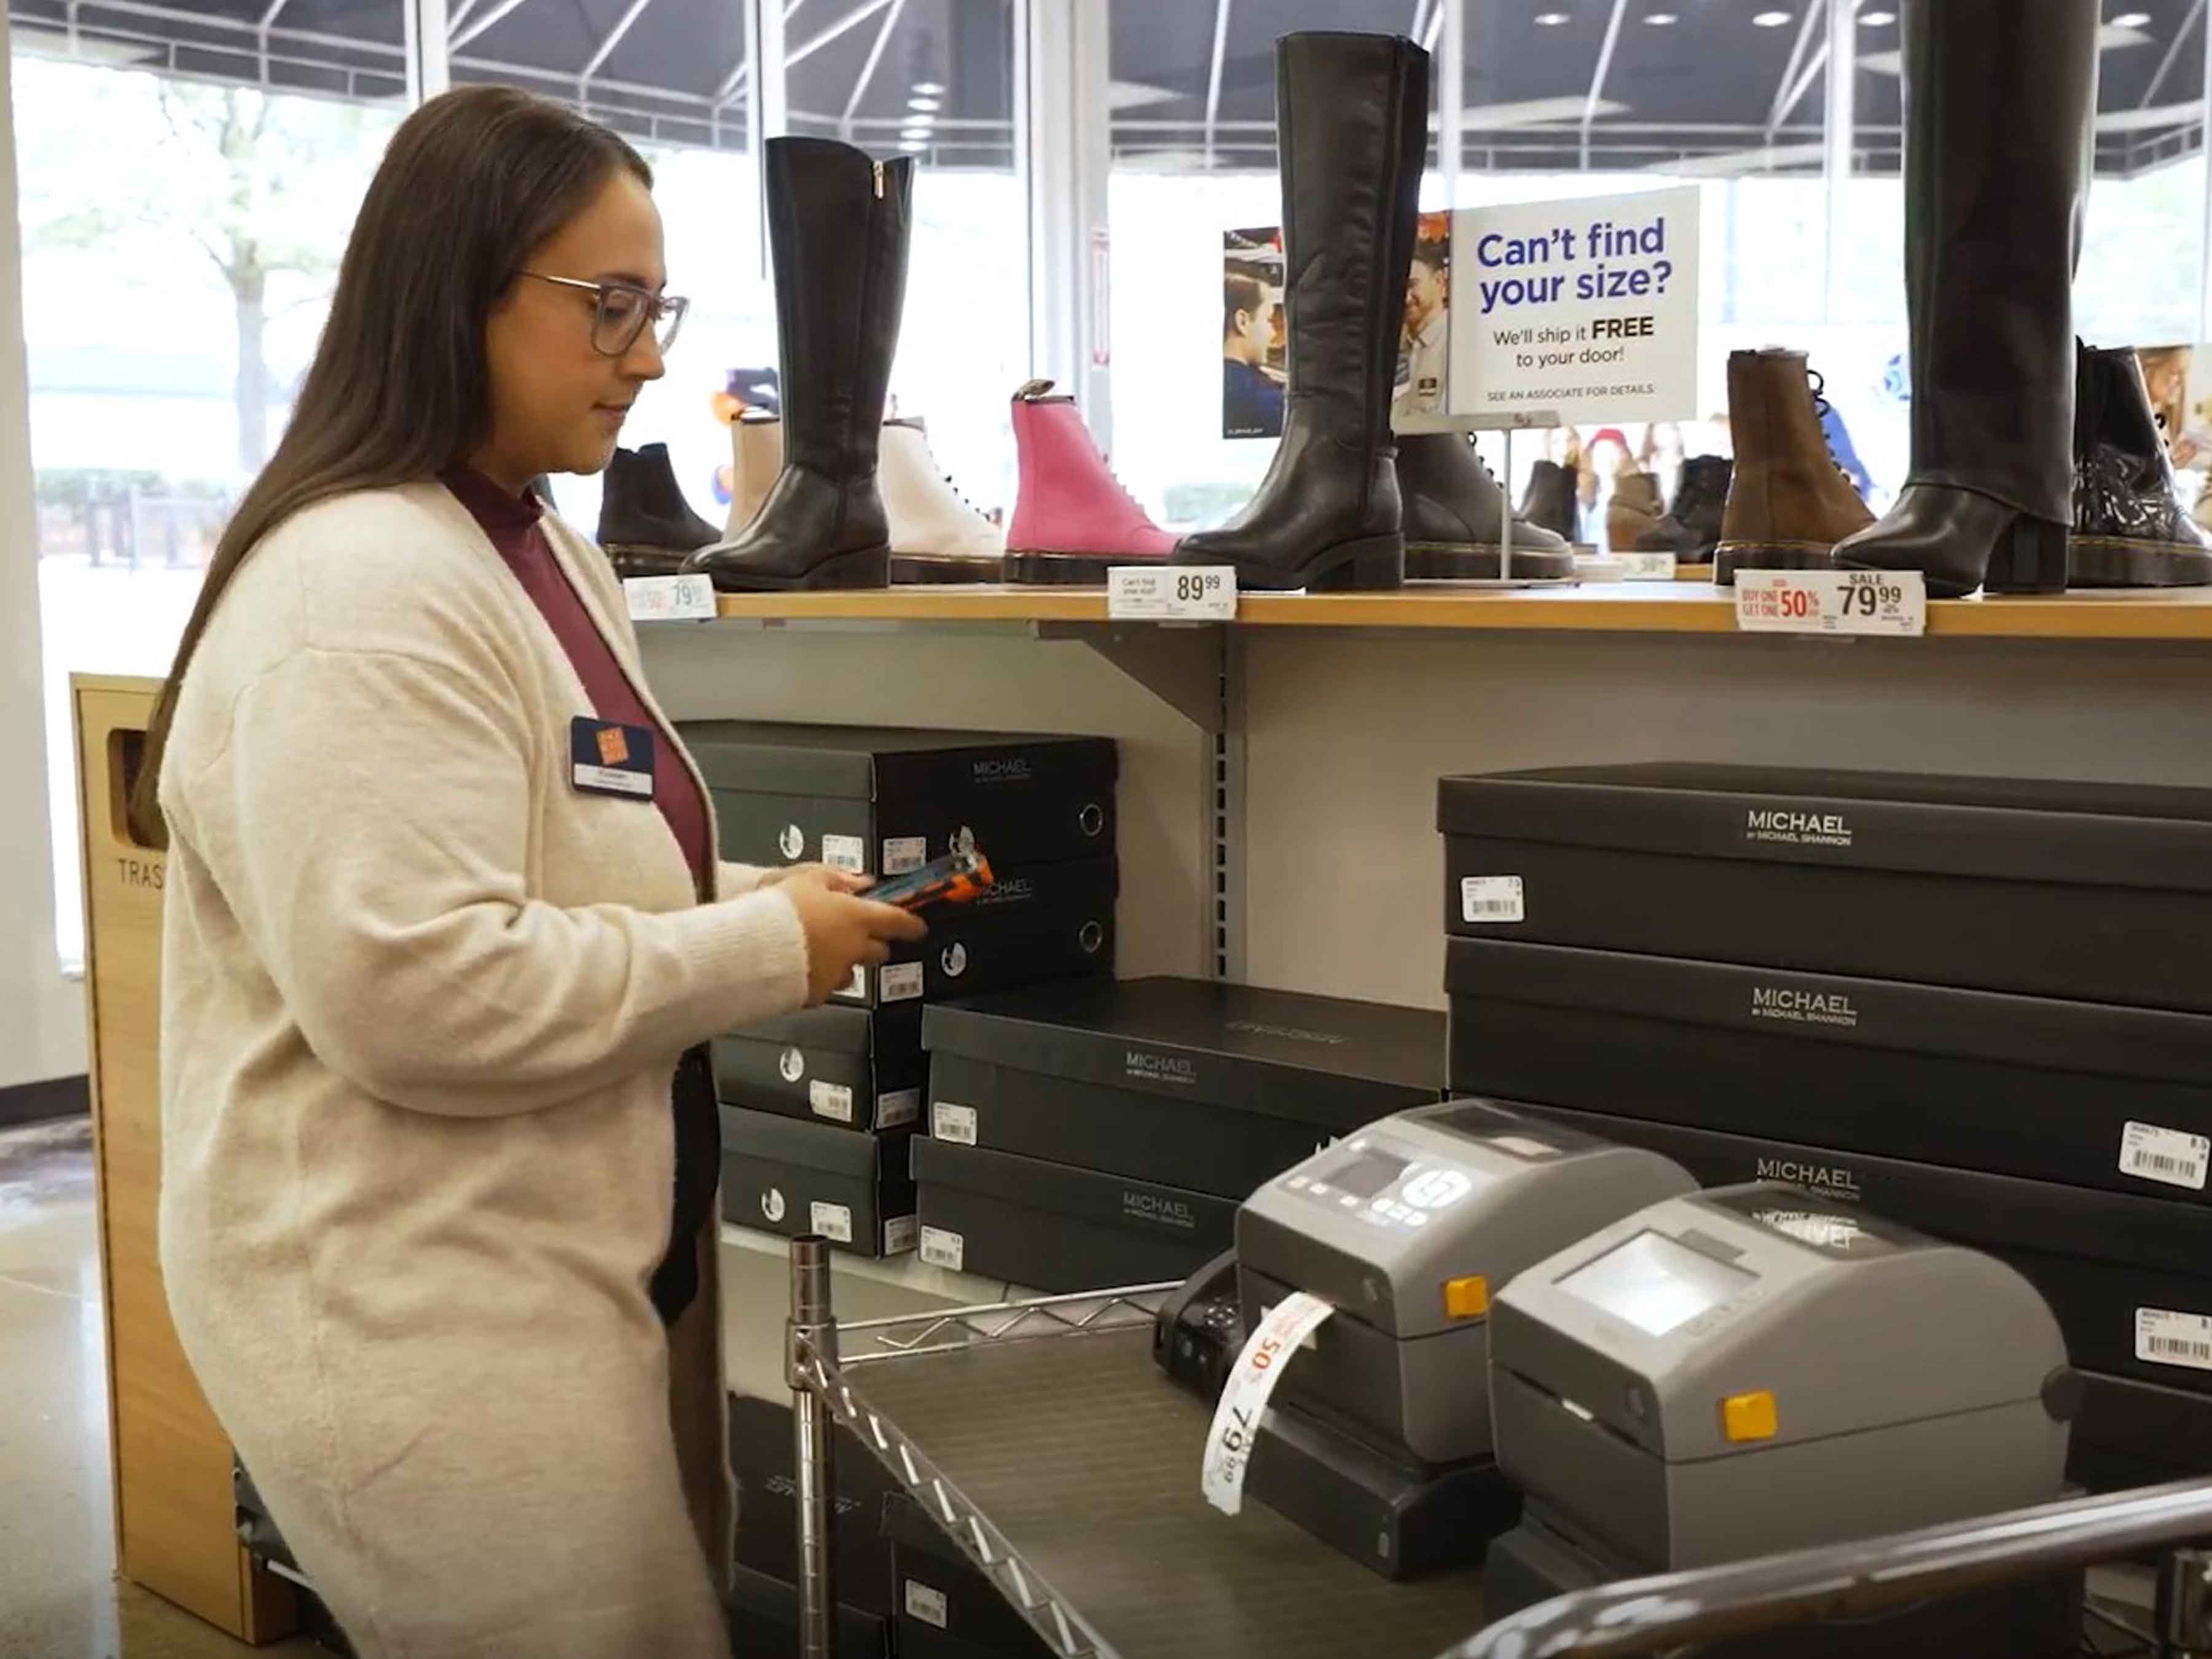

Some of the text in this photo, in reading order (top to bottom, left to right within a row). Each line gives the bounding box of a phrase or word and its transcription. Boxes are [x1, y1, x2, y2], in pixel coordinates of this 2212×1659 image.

[1477, 217, 1665, 267] Can't find
[1479, 261, 1673, 314] your size?
[1492, 316, 1655, 345] We'll ship it FREE
[1516, 346, 1625, 369] to your door!
[1487, 392, 1505, 402] SEE
[1508, 391, 1524, 400] AN
[1526, 388, 1584, 401] ASSOCIATE
[1586, 386, 1607, 398] FOR
[1849, 573, 1884, 584] SALE
[1760, 590, 1778, 602] ONE
[1760, 605, 1779, 616] ONE
[1747, 809, 1853, 835] MICHAEL
[117, 858, 164, 890] TRAS
[1752, 987, 1859, 1015] MICHAEL
[1126, 1051, 1198, 1076] MICHAEL
[1756, 1157, 1861, 1191] MICHAEL
[1123, 1191, 1194, 1220] MICHAEL
